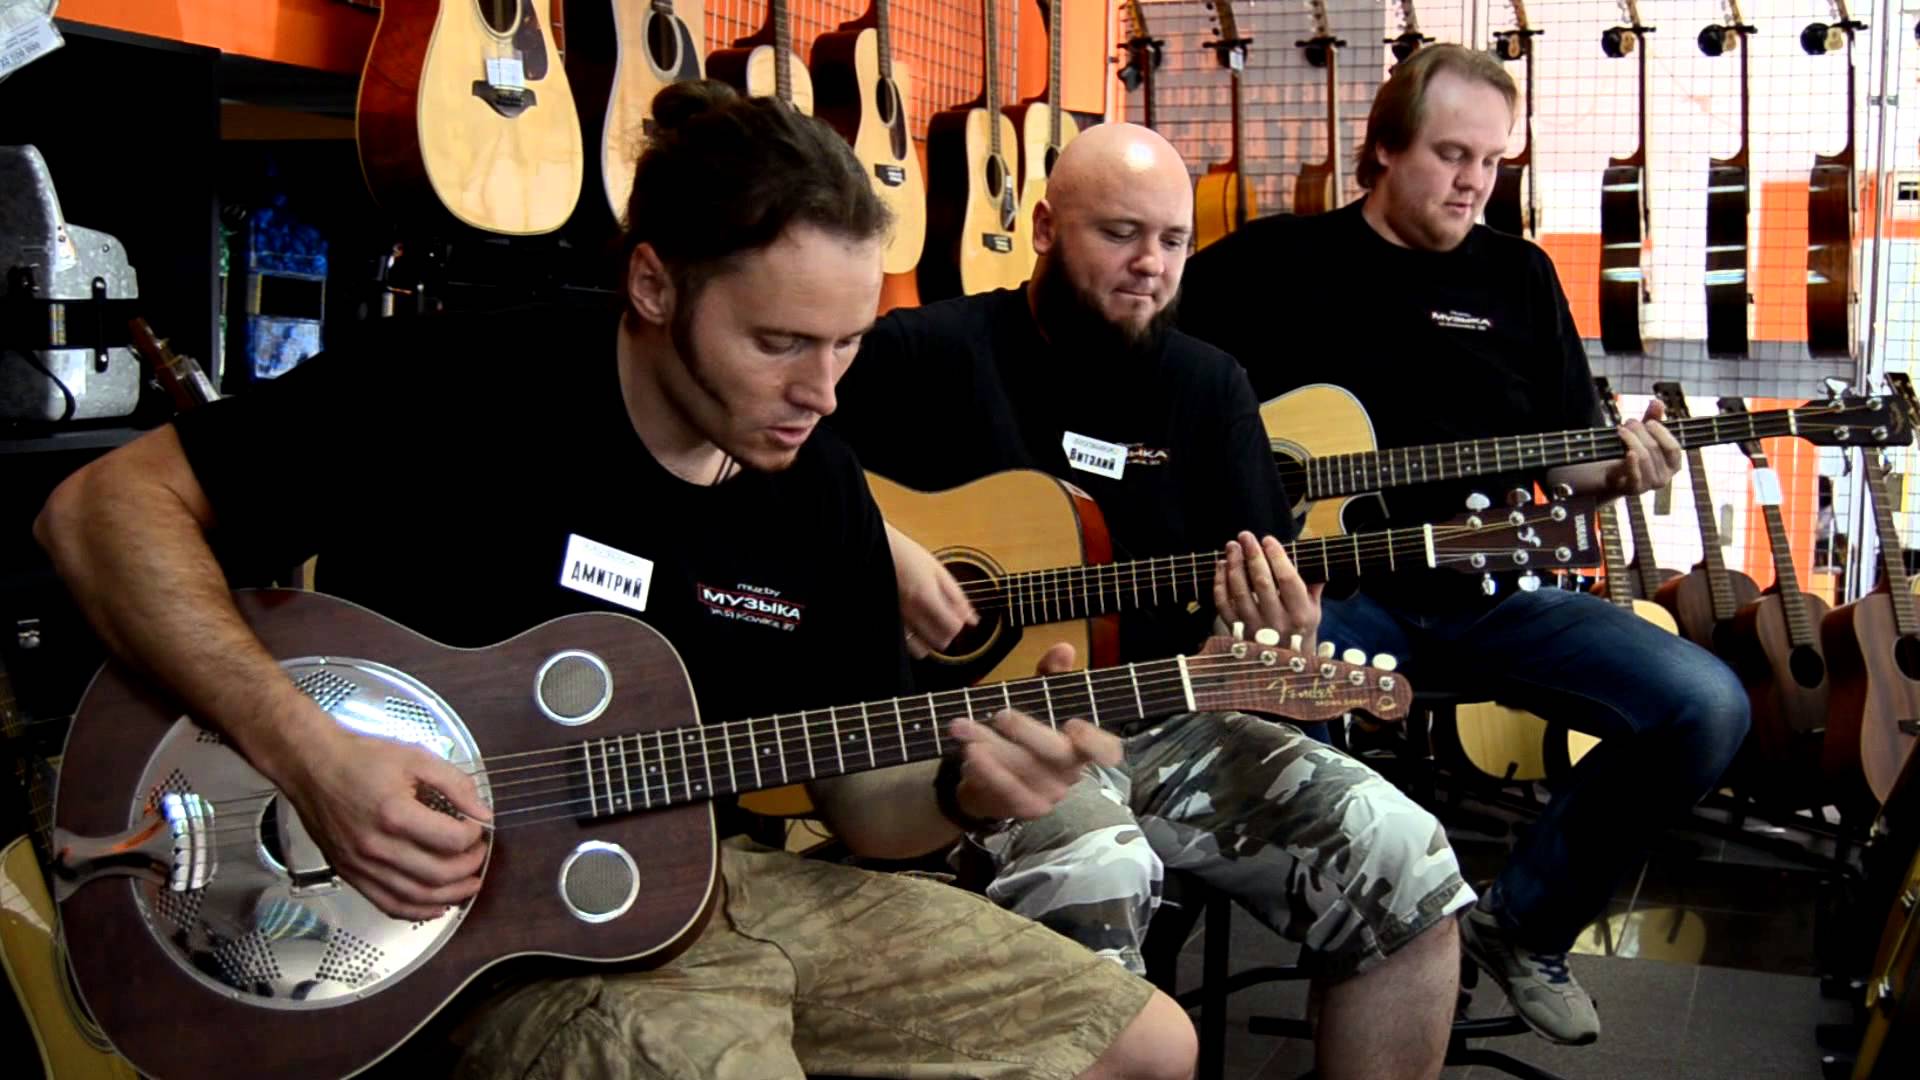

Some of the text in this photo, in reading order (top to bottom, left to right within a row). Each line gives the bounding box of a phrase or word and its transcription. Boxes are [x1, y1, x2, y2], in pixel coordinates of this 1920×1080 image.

[1574, 513, 1589, 552] YAMAHA
[571, 559, 643, 600] ДМИТРИЙ
[702, 587, 801, 620] МУЗЫКА
[1266, 676, 1337, 705] Fender
